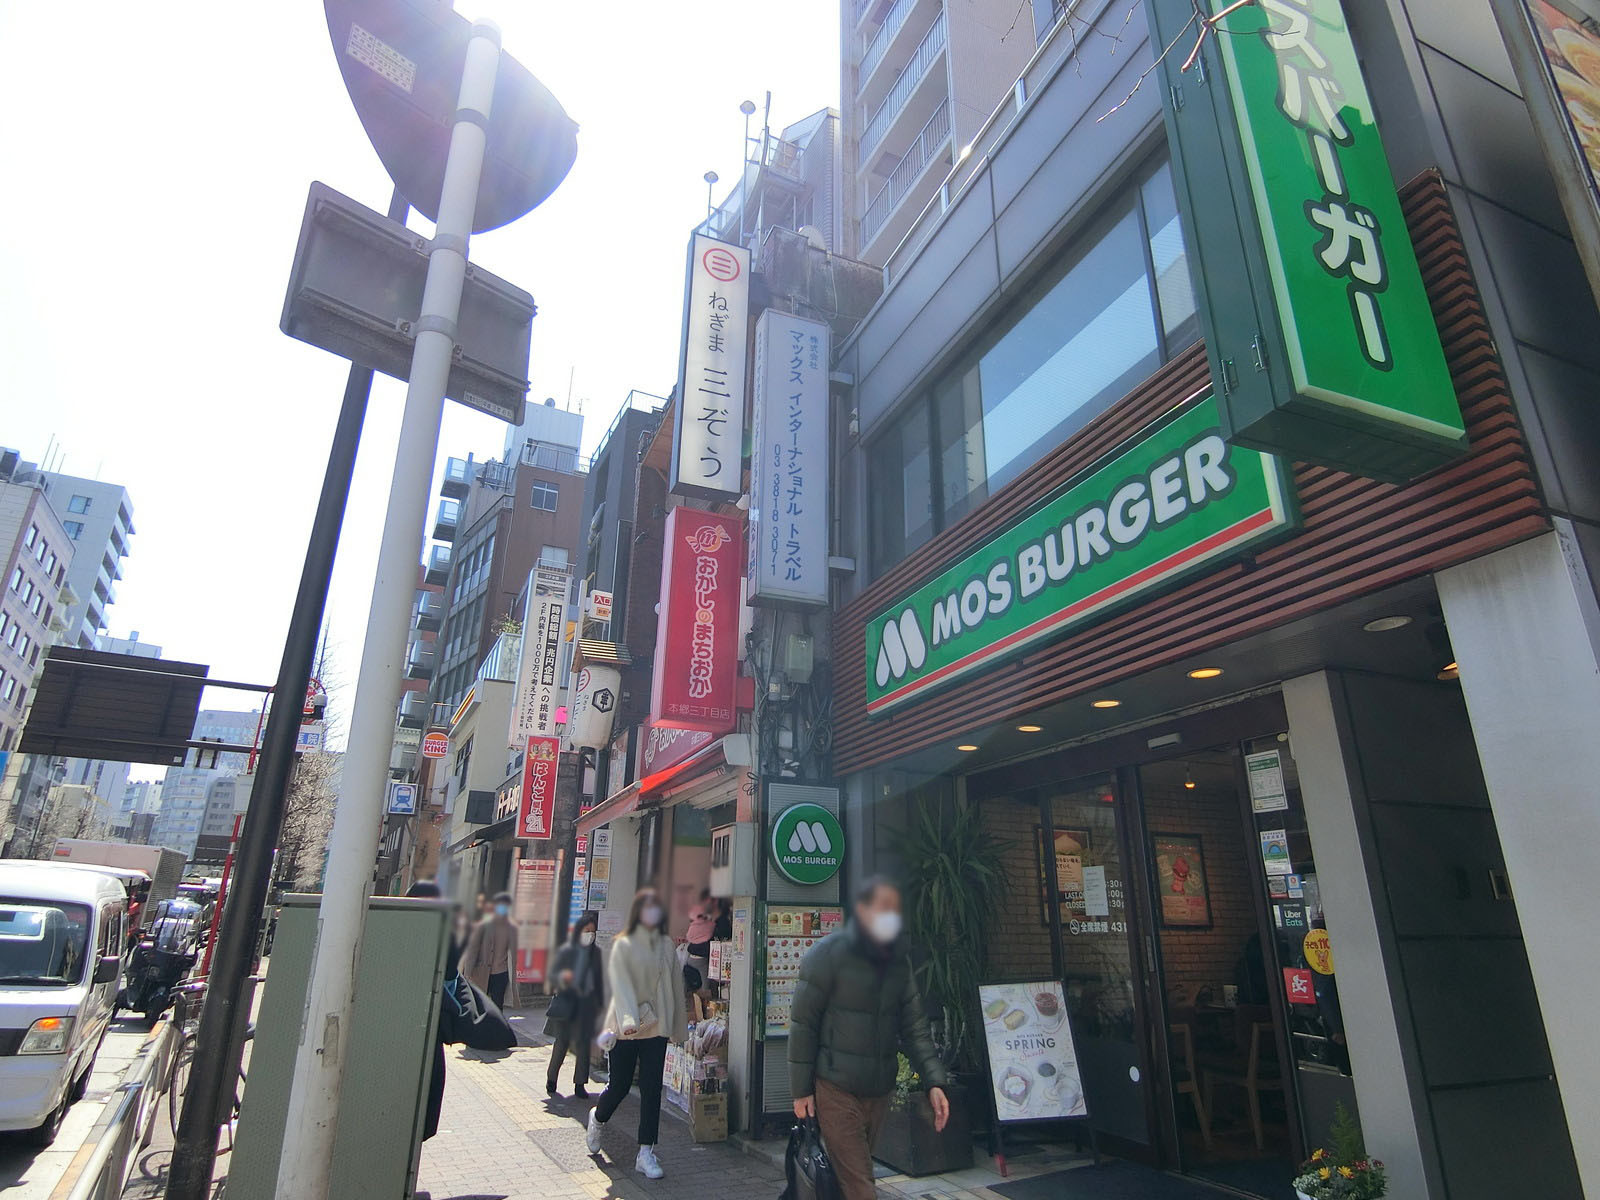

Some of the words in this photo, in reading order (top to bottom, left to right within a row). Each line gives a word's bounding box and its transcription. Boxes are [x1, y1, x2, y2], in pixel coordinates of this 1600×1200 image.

[708, 291, 730, 353] ねぎま
[789, 329, 804, 385] マックス
[697, 367, 731, 478] 三ぞう
[774, 443, 781, 468] 03
[786, 392, 804, 516] インターナショナル
[772, 473, 781, 522] 3818
[770, 526, 780, 577] 3071
[785, 523, 802, 582] トラベル
[932, 561, 1012, 645] MOS
[1017, 435, 1231, 599] BURGER
[594, 594, 612, 606] 入口
[688, 555, 719, 699] おかしのまちおか
[668, 703, 730, 720] 本郷三丁目店
[423, 745, 448, 754] KING
[783, 855, 802, 864] MOS
[804, 856, 837, 866] BURGER
[1064, 892, 1078, 900] LAST
[1284, 910, 1302, 919] Uber
[1285, 918, 1304, 927] Eats
[1005, 1037, 1056, 1051] SPRING
